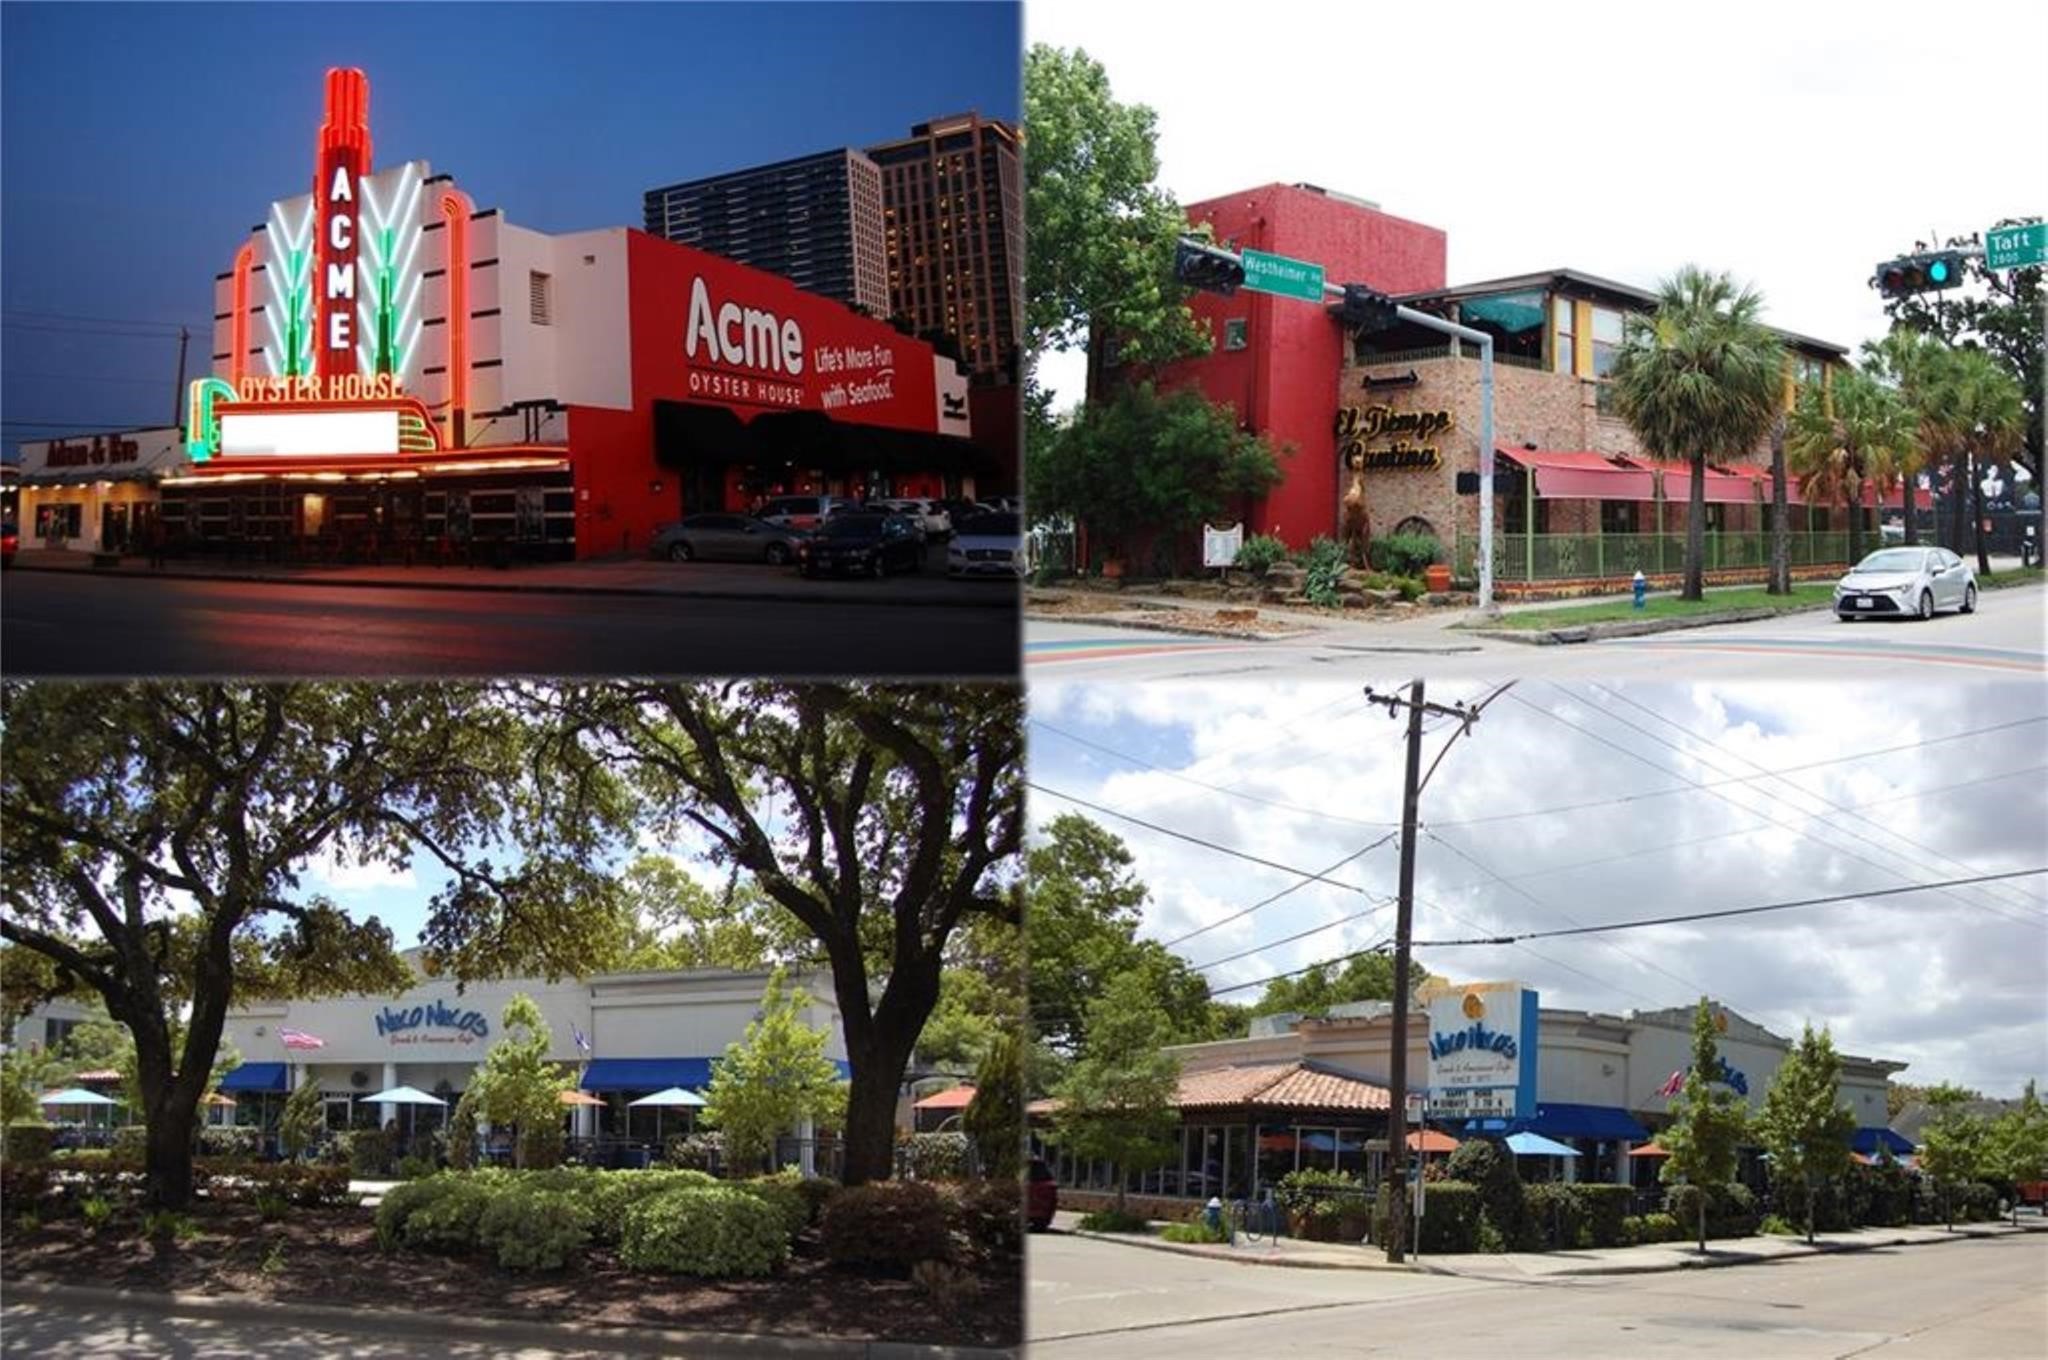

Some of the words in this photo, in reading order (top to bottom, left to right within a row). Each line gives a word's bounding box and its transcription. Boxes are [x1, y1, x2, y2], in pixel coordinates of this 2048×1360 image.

[1990, 231, 2031, 251] Taft
[327, 166, 355, 349] ACME
[1245, 256, 1306, 283] Westheimer
[686, 276, 803, 375] Acme
[814, 346, 844, 374] Life's
[845, 346, 873, 369] More
[873, 344, 893, 367] Fun
[240, 375, 322, 402] OYSTER
[329, 372, 403, 400] HOUSE
[689, 372, 750, 398] OYSTER
[758, 384, 801, 405] HOUSE
[821, 383, 848, 409] with
